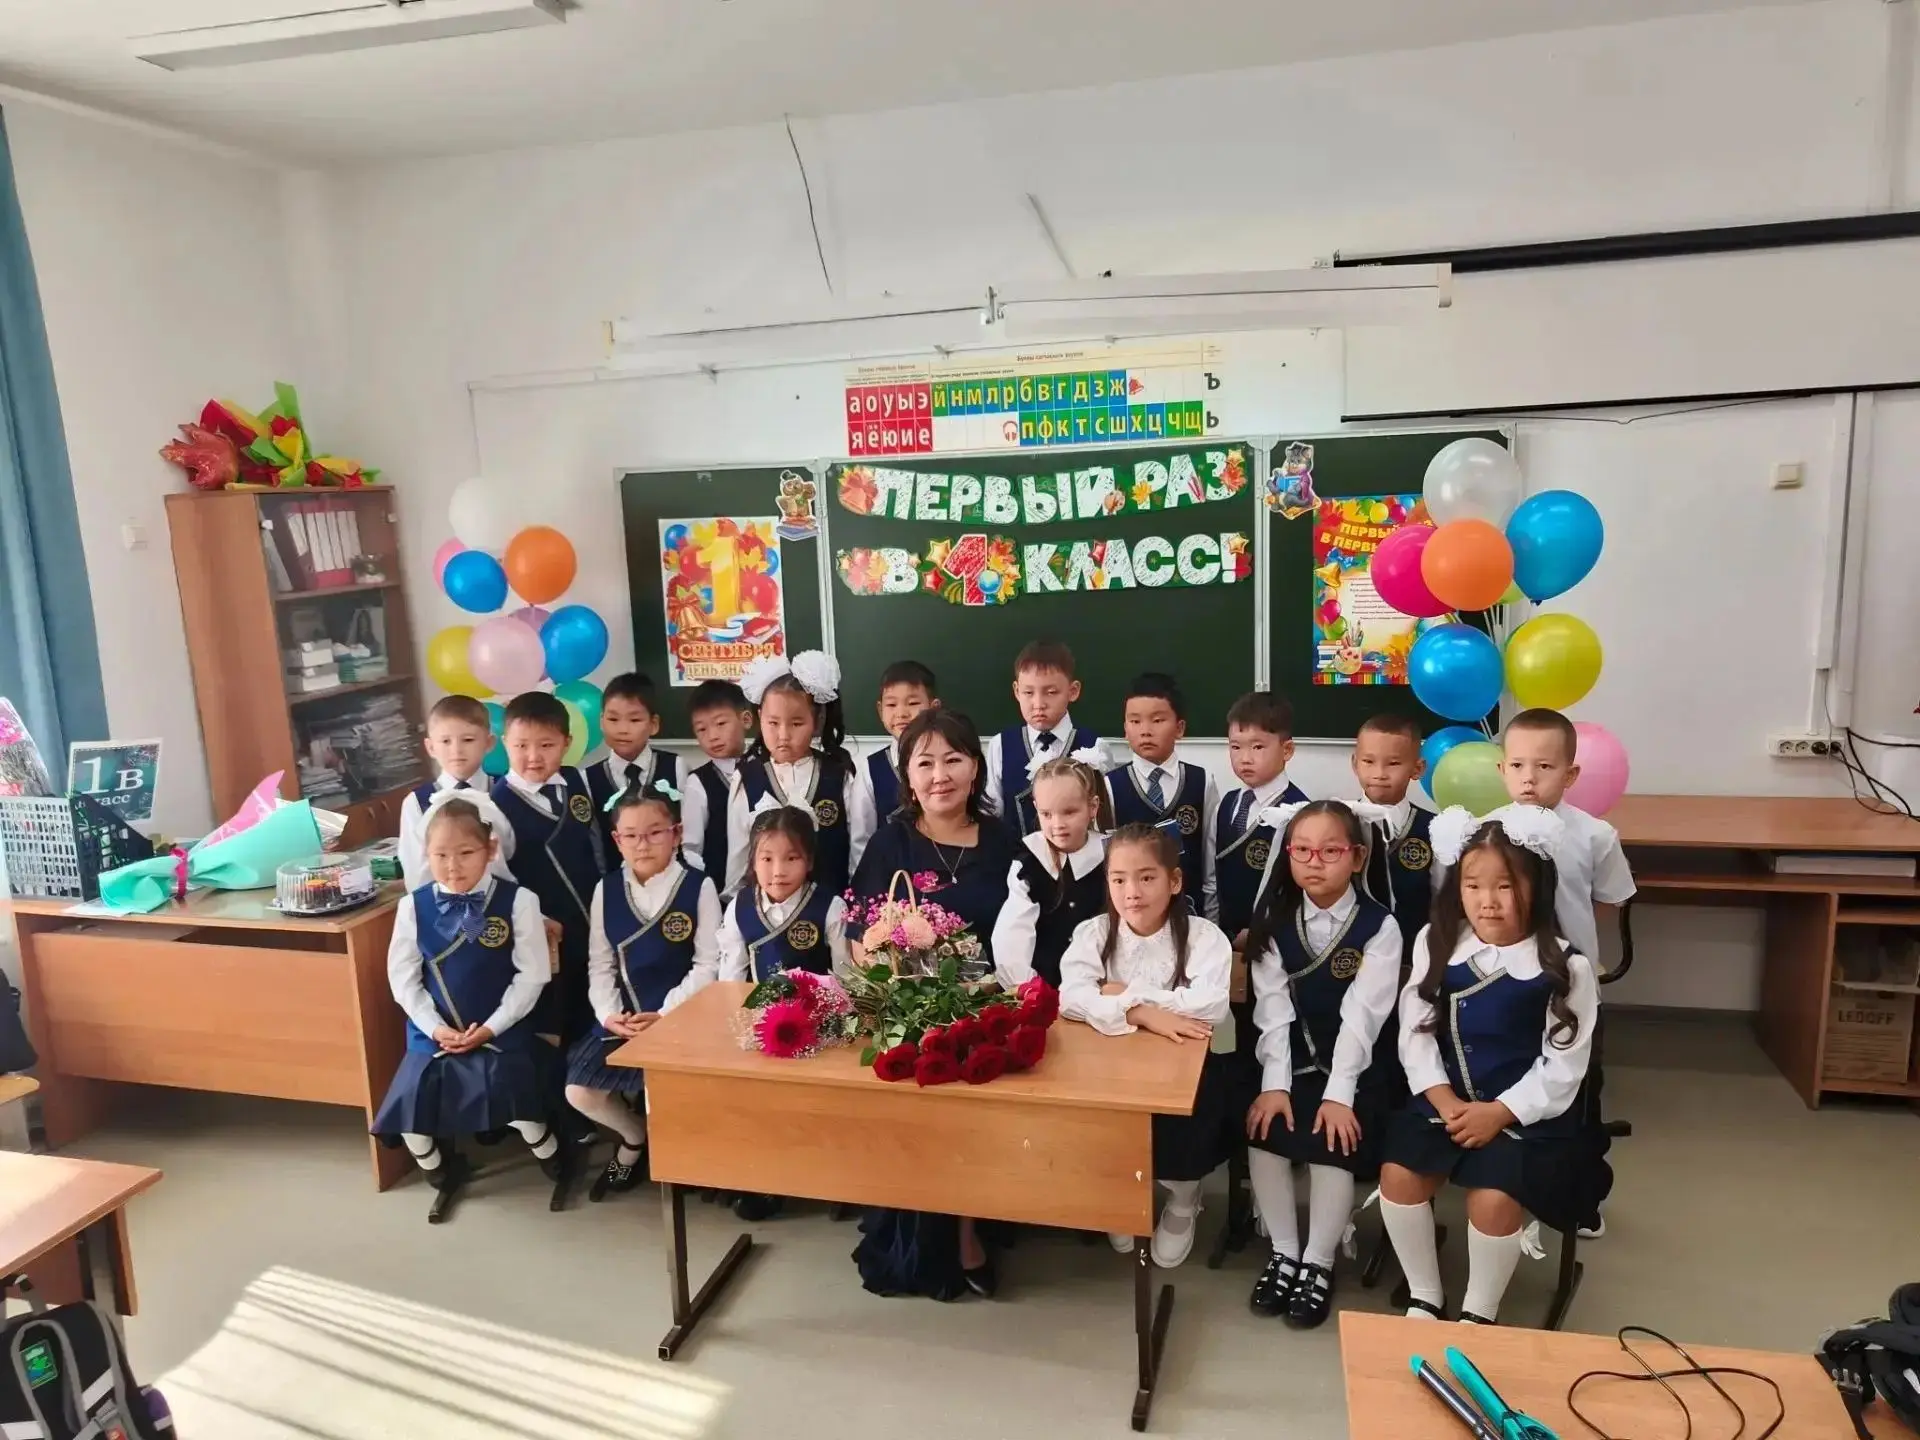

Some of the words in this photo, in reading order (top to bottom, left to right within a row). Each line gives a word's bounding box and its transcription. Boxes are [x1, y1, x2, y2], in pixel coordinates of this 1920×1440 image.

[870, 466, 1117, 524] ПЕРВЫЙ
[1134, 451, 1237, 510] РАЗ
[882, 548, 919, 593] В
[943, 533, 988, 606] 1
[1023, 532, 1237, 594] КЛАСС!
[1320, 532, 1332, 544] В
[1333, 535, 1378, 553] ПЕРВ
[696, 536, 740, 628] 1
